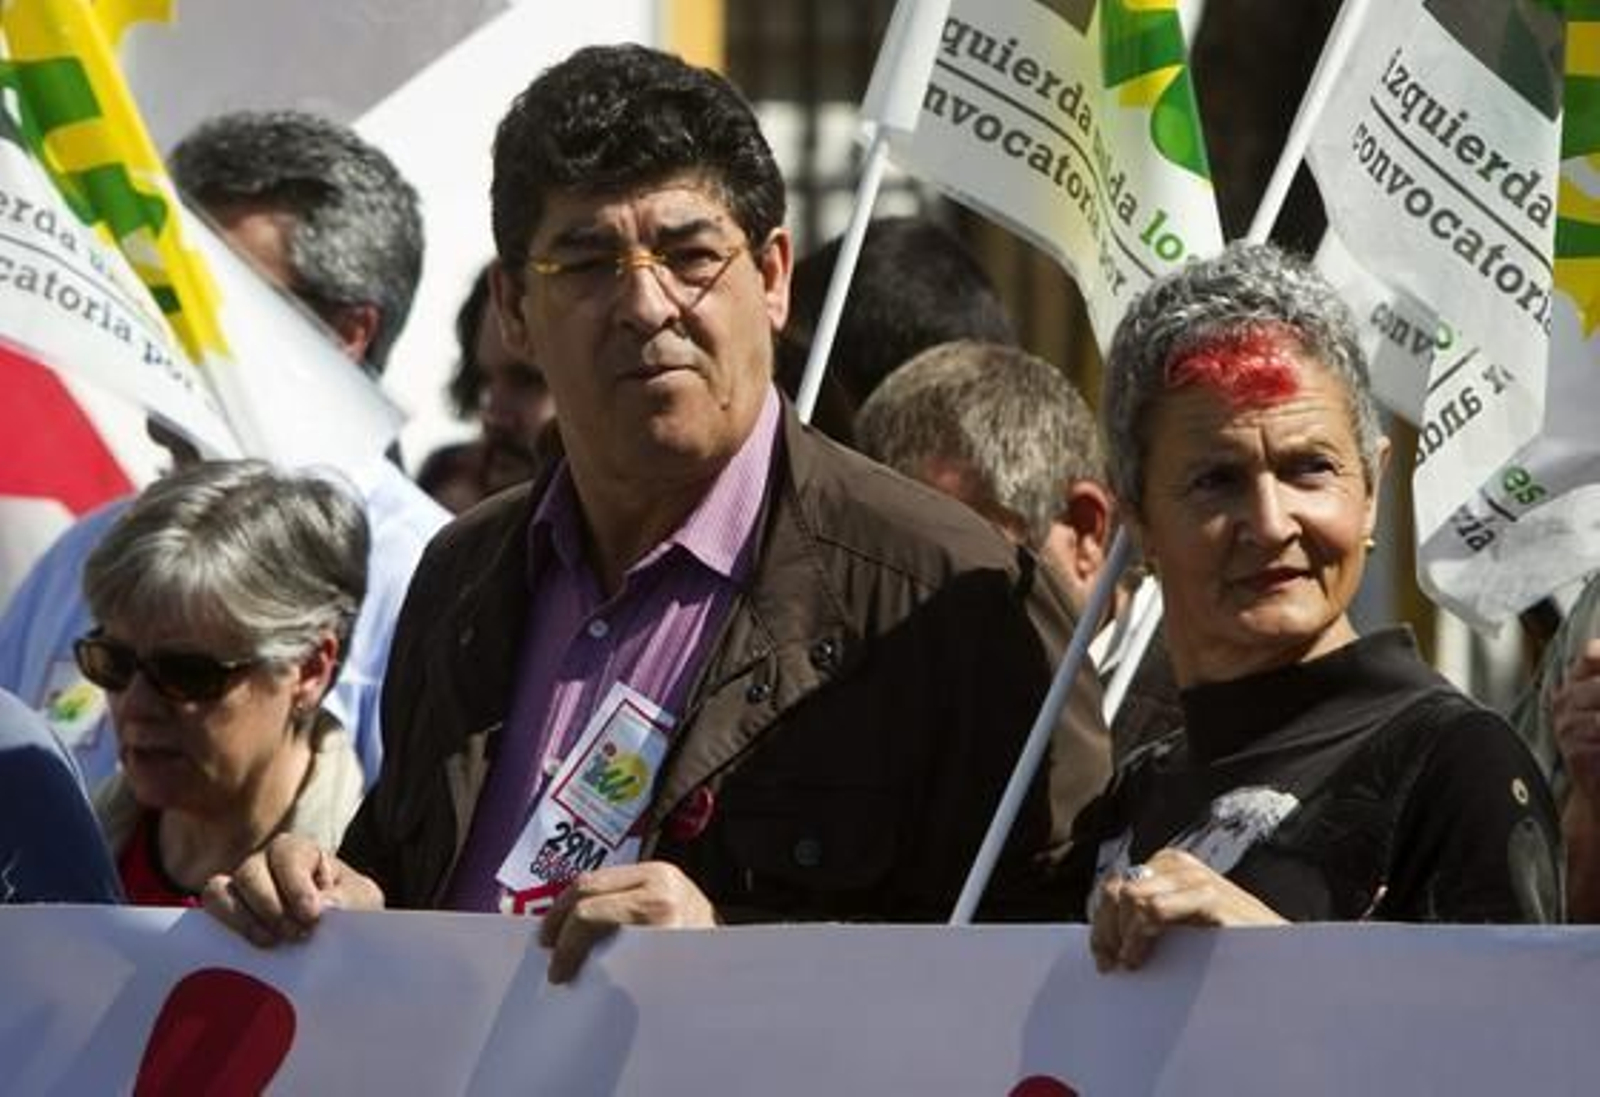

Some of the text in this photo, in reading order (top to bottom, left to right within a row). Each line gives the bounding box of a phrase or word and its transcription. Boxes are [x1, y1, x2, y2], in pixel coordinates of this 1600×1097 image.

[923, 83, 1099, 225] nvocator
[1381, 48, 1553, 229] izquierda
[1139, 208, 1190, 265] lo
[547, 822, 609, 872] 29M
